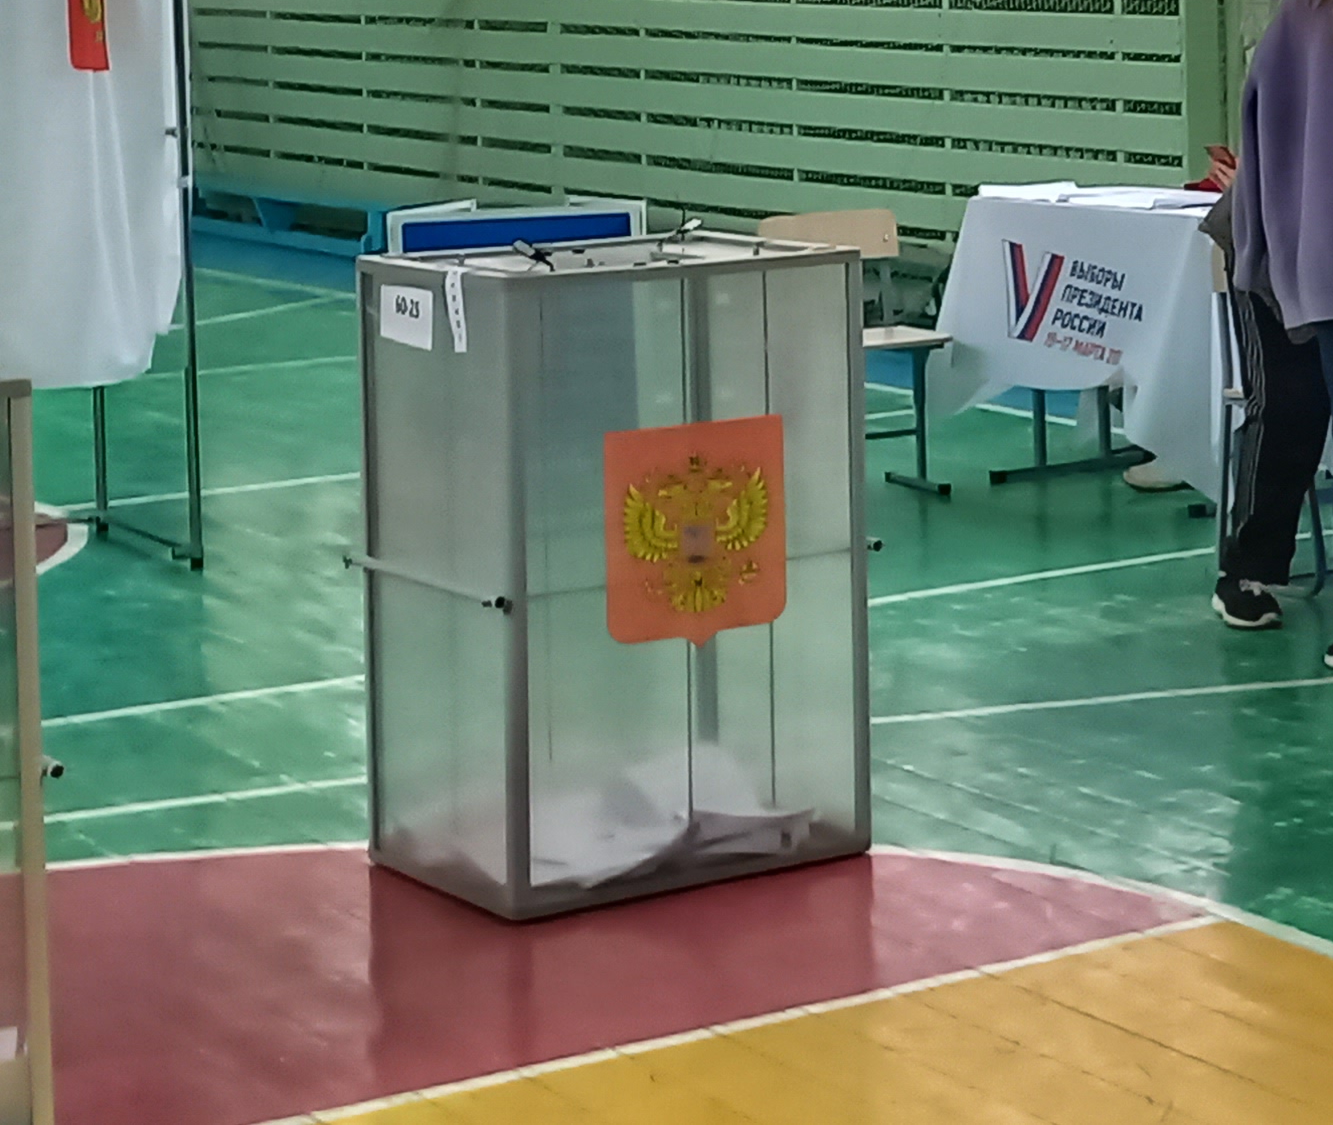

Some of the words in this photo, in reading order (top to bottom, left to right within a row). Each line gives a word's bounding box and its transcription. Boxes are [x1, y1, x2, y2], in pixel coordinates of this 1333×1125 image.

[1069, 260, 1126, 291] ВЫБОРЫ
[1060, 284, 1143, 322] ПРЕЗИДЕНТА
[1051, 308, 1107, 338] РОССИИ
